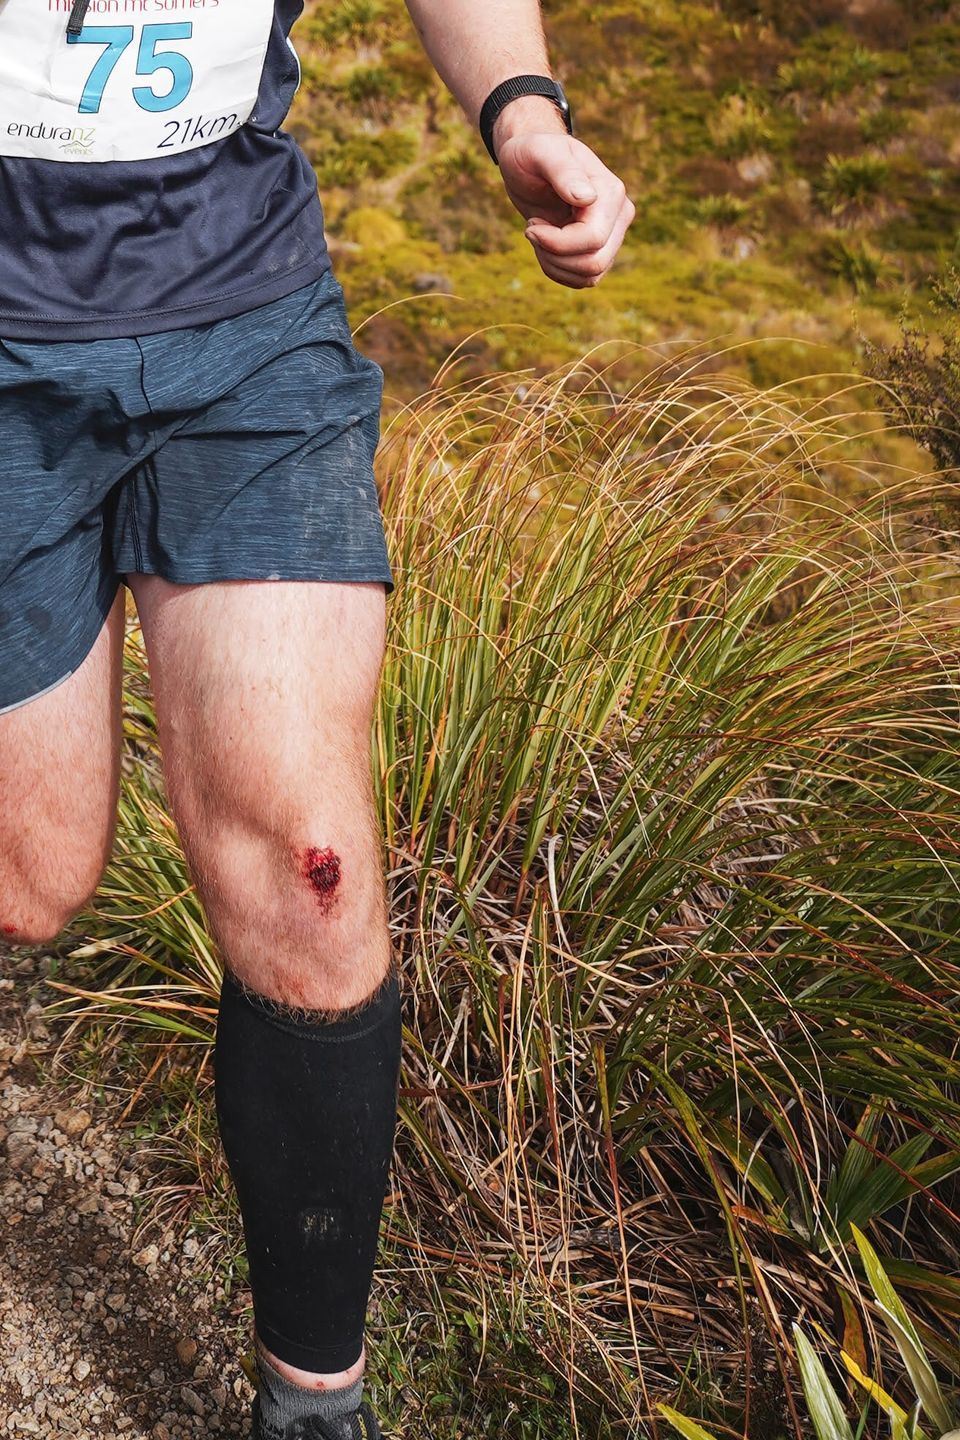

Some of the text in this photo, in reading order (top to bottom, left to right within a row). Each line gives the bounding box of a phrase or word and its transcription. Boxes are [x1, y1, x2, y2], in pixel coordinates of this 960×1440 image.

[66, 21, 194, 114] 75
[6, 121, 96, 141] enduranz
[157, 113, 238, 148] 21km
[63, 147, 94, 155] events
